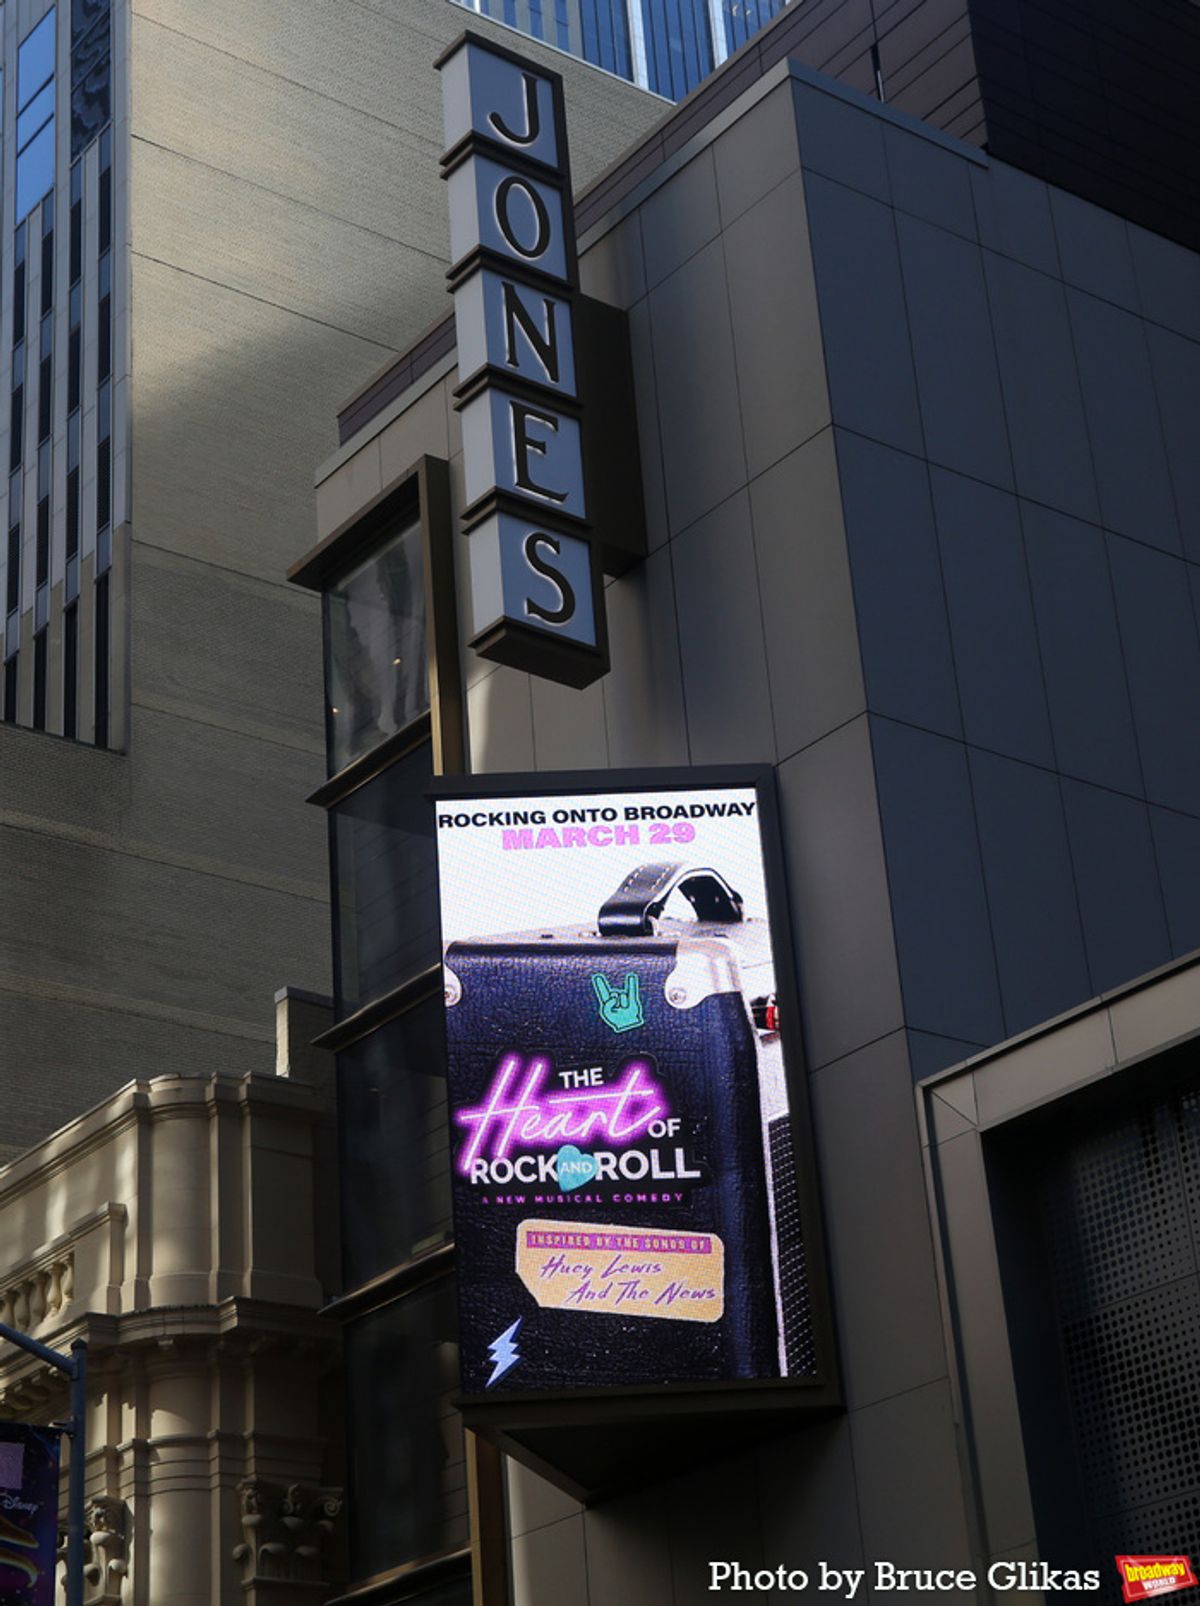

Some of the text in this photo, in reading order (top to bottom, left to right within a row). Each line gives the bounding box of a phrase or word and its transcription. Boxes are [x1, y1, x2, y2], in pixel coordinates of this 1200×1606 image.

[487, 72, 576, 625] JONES
[438, 802, 756, 828] ROCKING ONTO BROADWAY
[502, 822, 696, 850] MARCH 29
[558, 1068, 604, 1089] THE
[457, 1058, 682, 1172] Heart OF
[470, 1148, 701, 1184] ROCK AND ROLL
[496, 1196, 526, 1204] NEW
[535, 1195, 603, 1203] MUSICAL
[612, 1193, 683, 1202] COMEDY
[617, 1238, 639, 1248] THE
[540, 1254, 662, 1279] Huey Lewis
[566, 1280, 716, 1305] And The News
